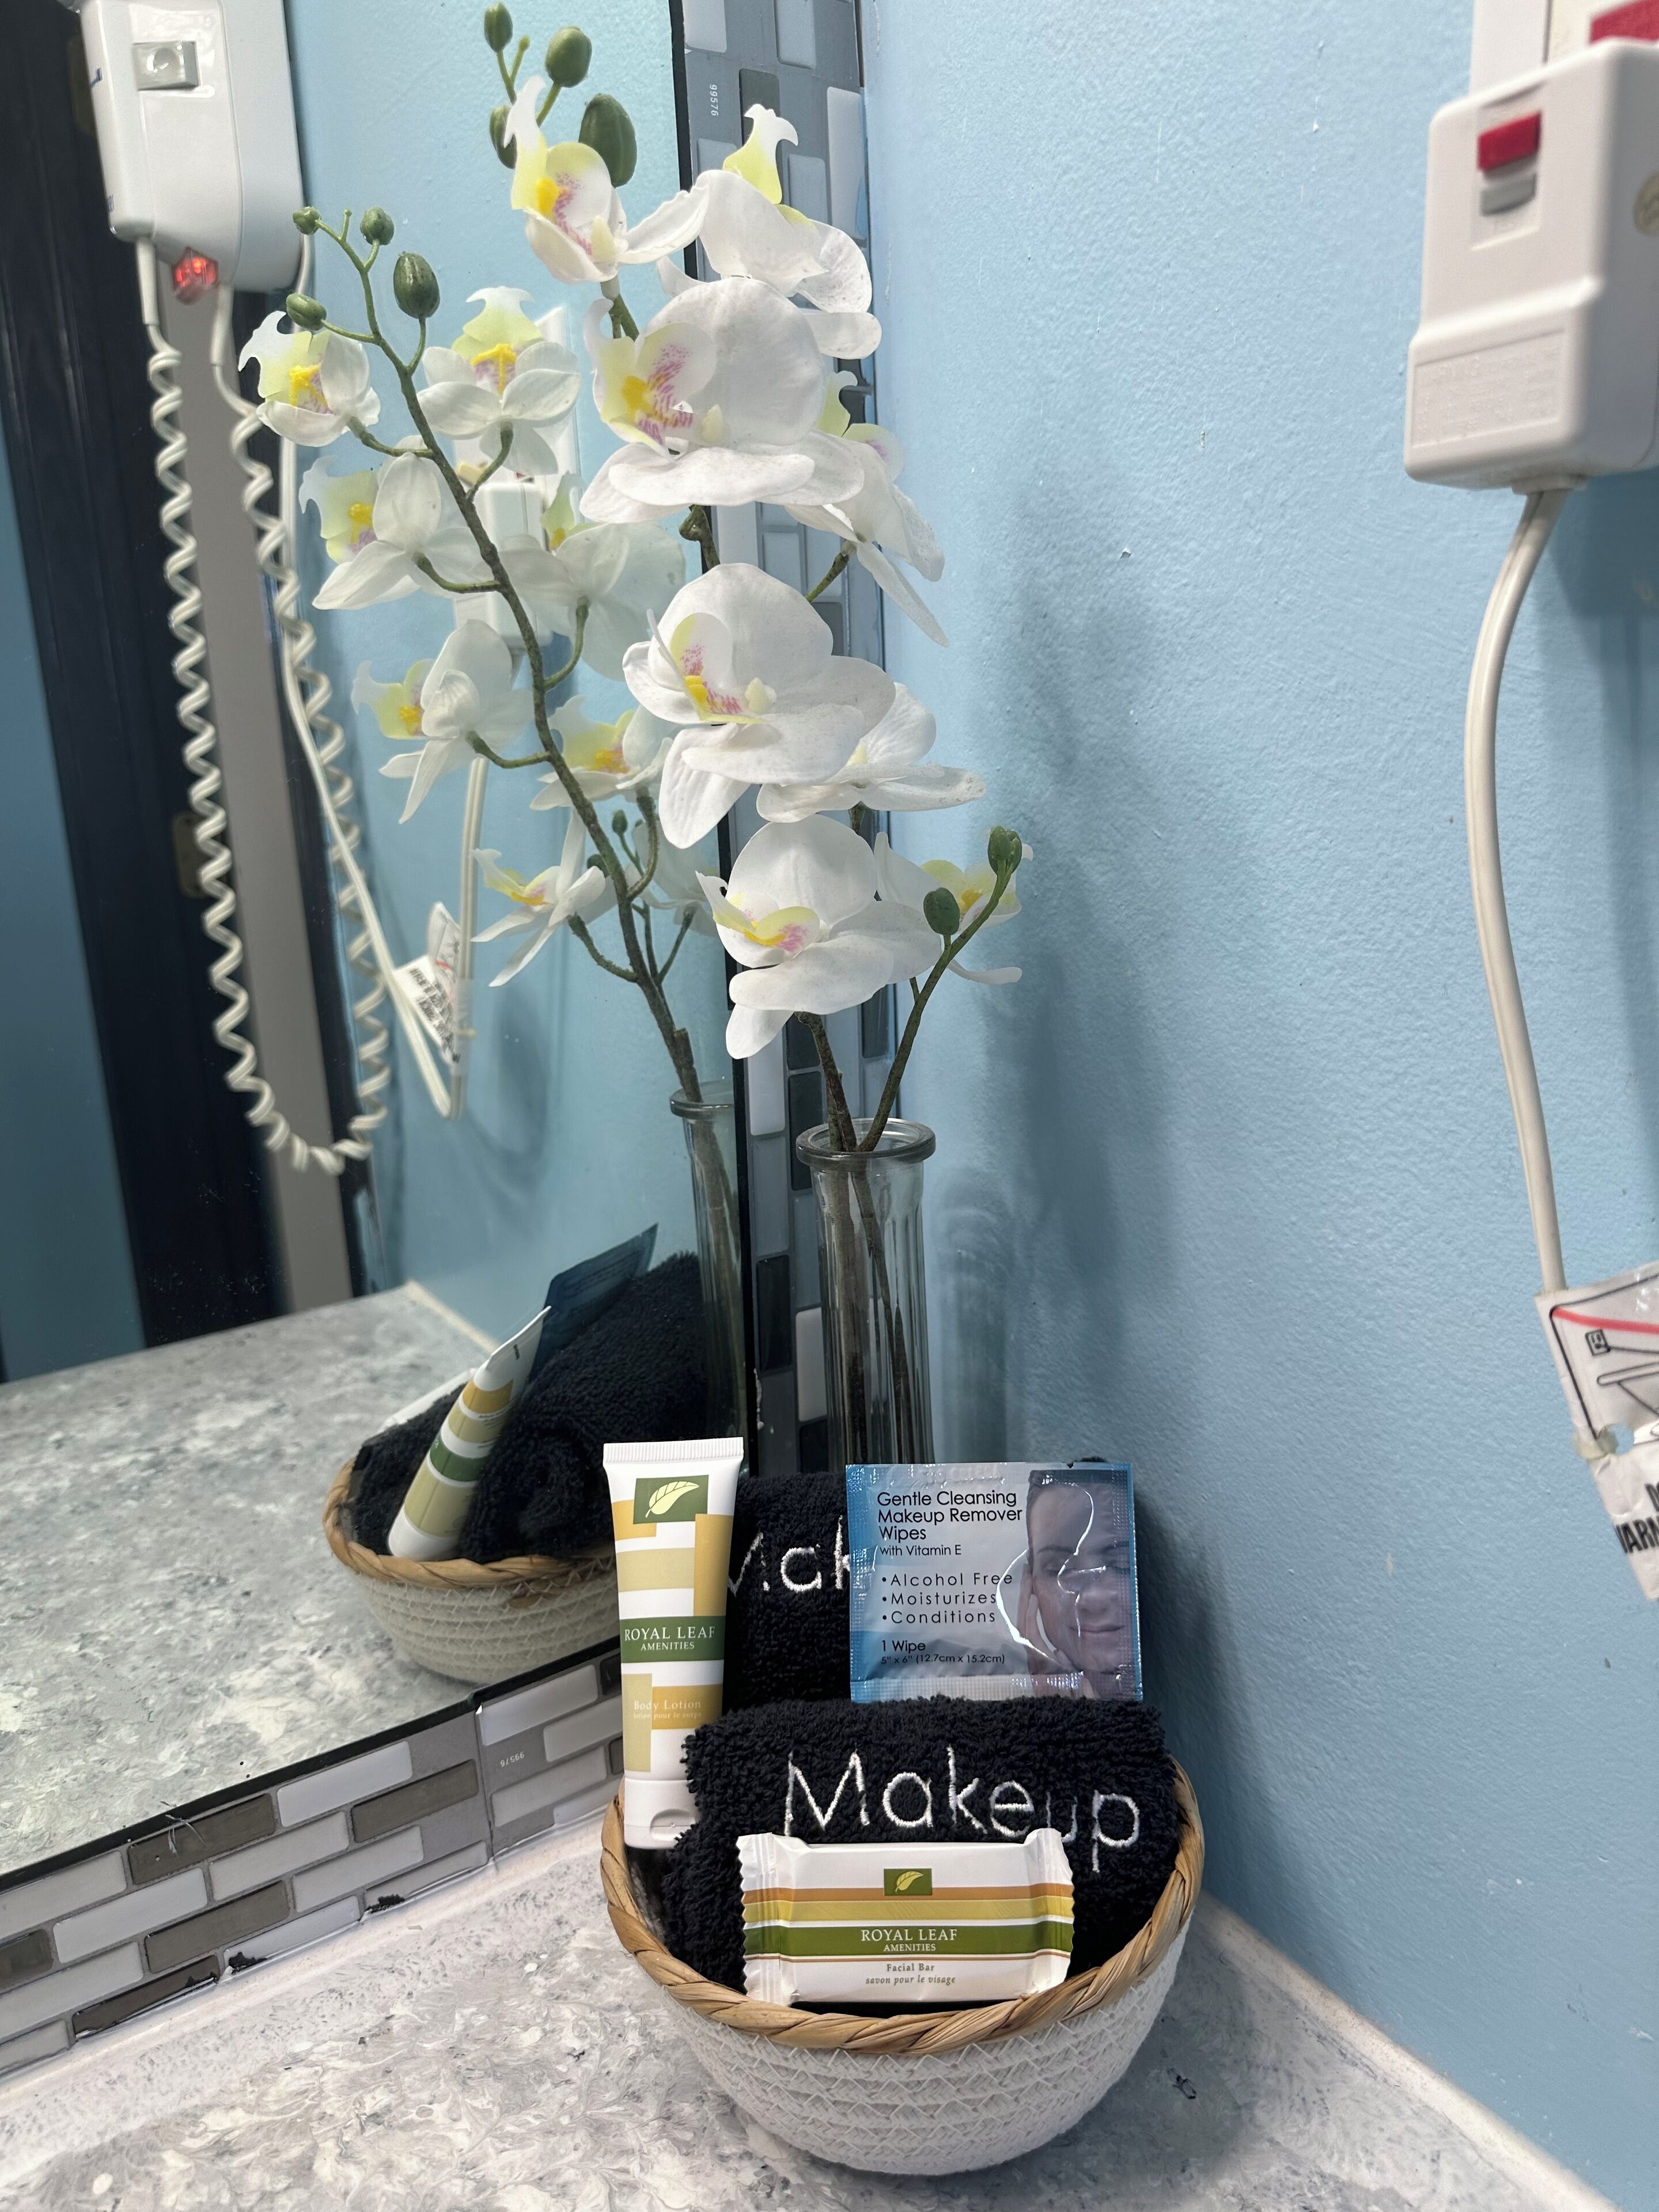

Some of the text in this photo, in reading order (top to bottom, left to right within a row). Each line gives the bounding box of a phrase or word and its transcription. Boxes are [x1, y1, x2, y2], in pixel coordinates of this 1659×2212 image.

[709, 84, 719, 116] 99576
[877, 1490, 1017, 1507] Gentle Cleansing
[878, 1508, 1023, 1525] Makeup Remover
[879, 1525, 927, 1543] Wipes
[880, 1544, 961, 1556] with Vitamin E
[891, 1573, 1013, 1586] Alcohol Free
[891, 1591, 996, 1605] Moisturizes
[891, 1611, 995, 1623] Conditions
[624, 1626, 715, 1641] ROYAL LEAF
[640, 1642, 695, 1651] AMENITIES
[882, 1640, 926, 1653] 1 Wipe
[881, 1656, 891, 1664] 5"
[903, 1656, 912, 1664] 6"
[916, 1654, 955, 1664] (12.7cm
[967, 1654, 1005, 1664] 15.2cm)
[634, 1699, 701, 1714] Body Lotion
[653, 1713, 671, 1721] pour
[784, 1744, 1141, 1873] Makeup
[861, 1929, 957, 1941] ROYAL LEAF
[884, 1943, 936, 1952] AMENITIES
[887, 1963, 935, 1972] Facial Bar
[894, 1976, 914, 1986] pour
[918, 1975, 925, 1983] le
[929, 1975, 956, 1986] visage
